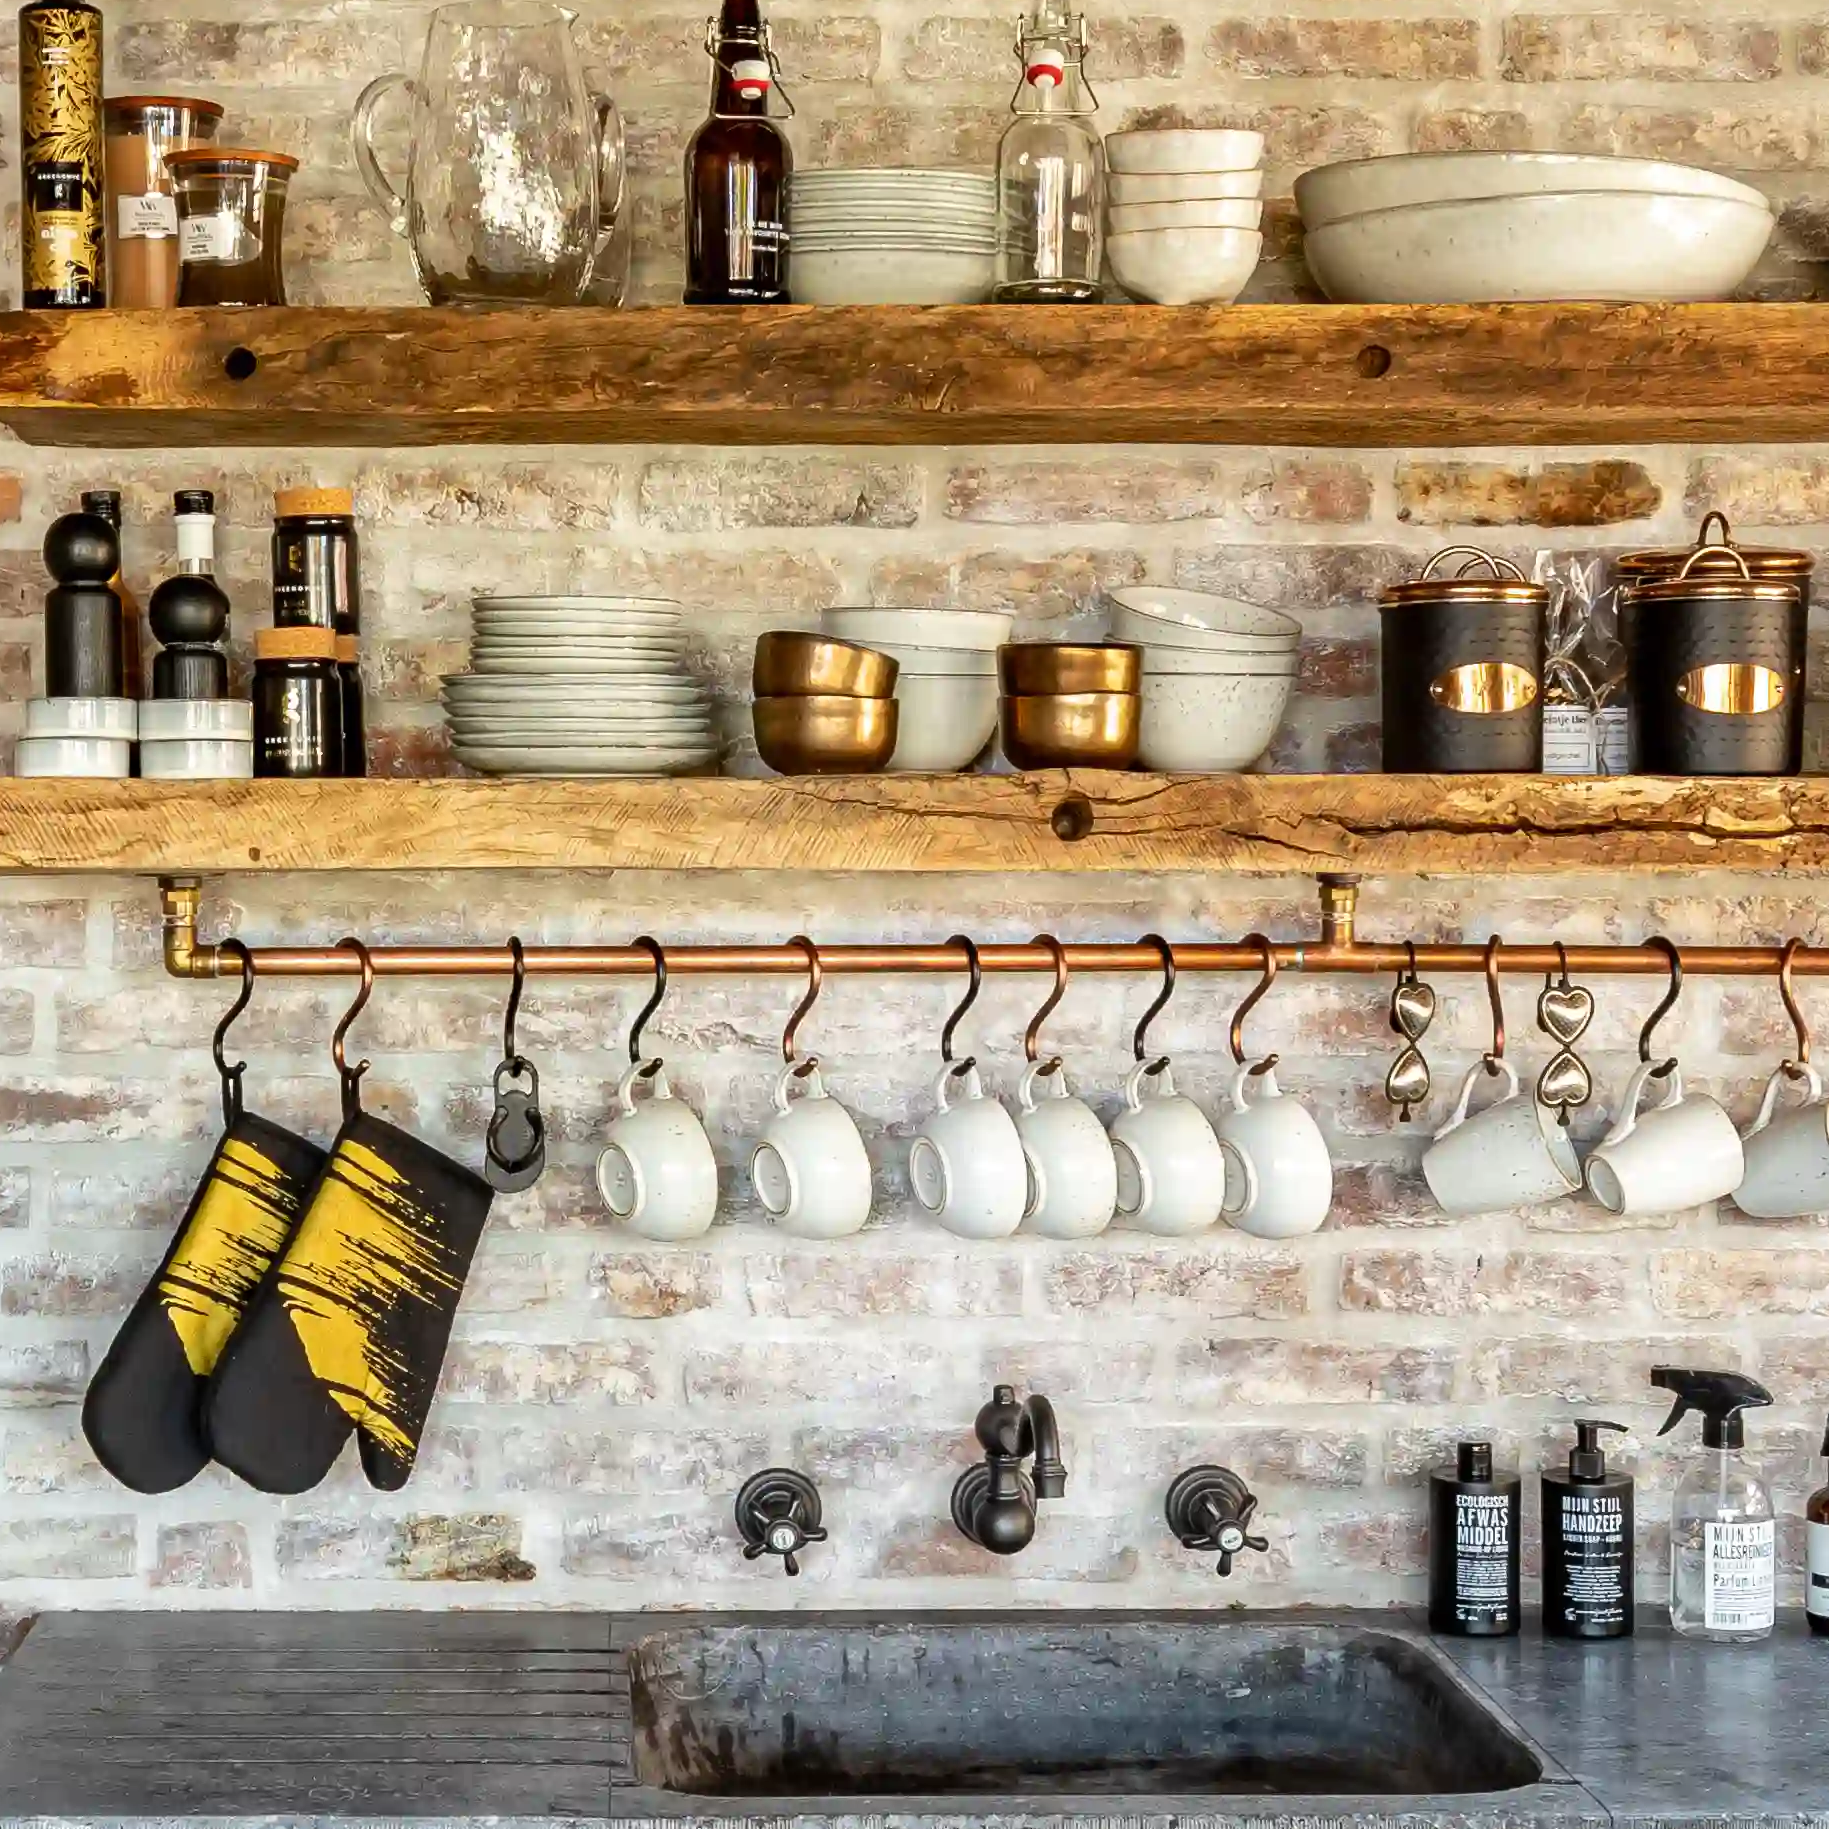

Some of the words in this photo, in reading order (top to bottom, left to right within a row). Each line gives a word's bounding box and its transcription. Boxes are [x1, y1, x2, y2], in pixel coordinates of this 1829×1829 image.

[1562, 1496, 1590, 1513] MIJN
[1592, 1496, 1623, 1514] STIJL
[1456, 1507, 1509, 1527] AFWAS
[1562, 1512, 1623, 1533] HANDZEEP
[1457, 1525, 1509, 1546] MIDDEL
